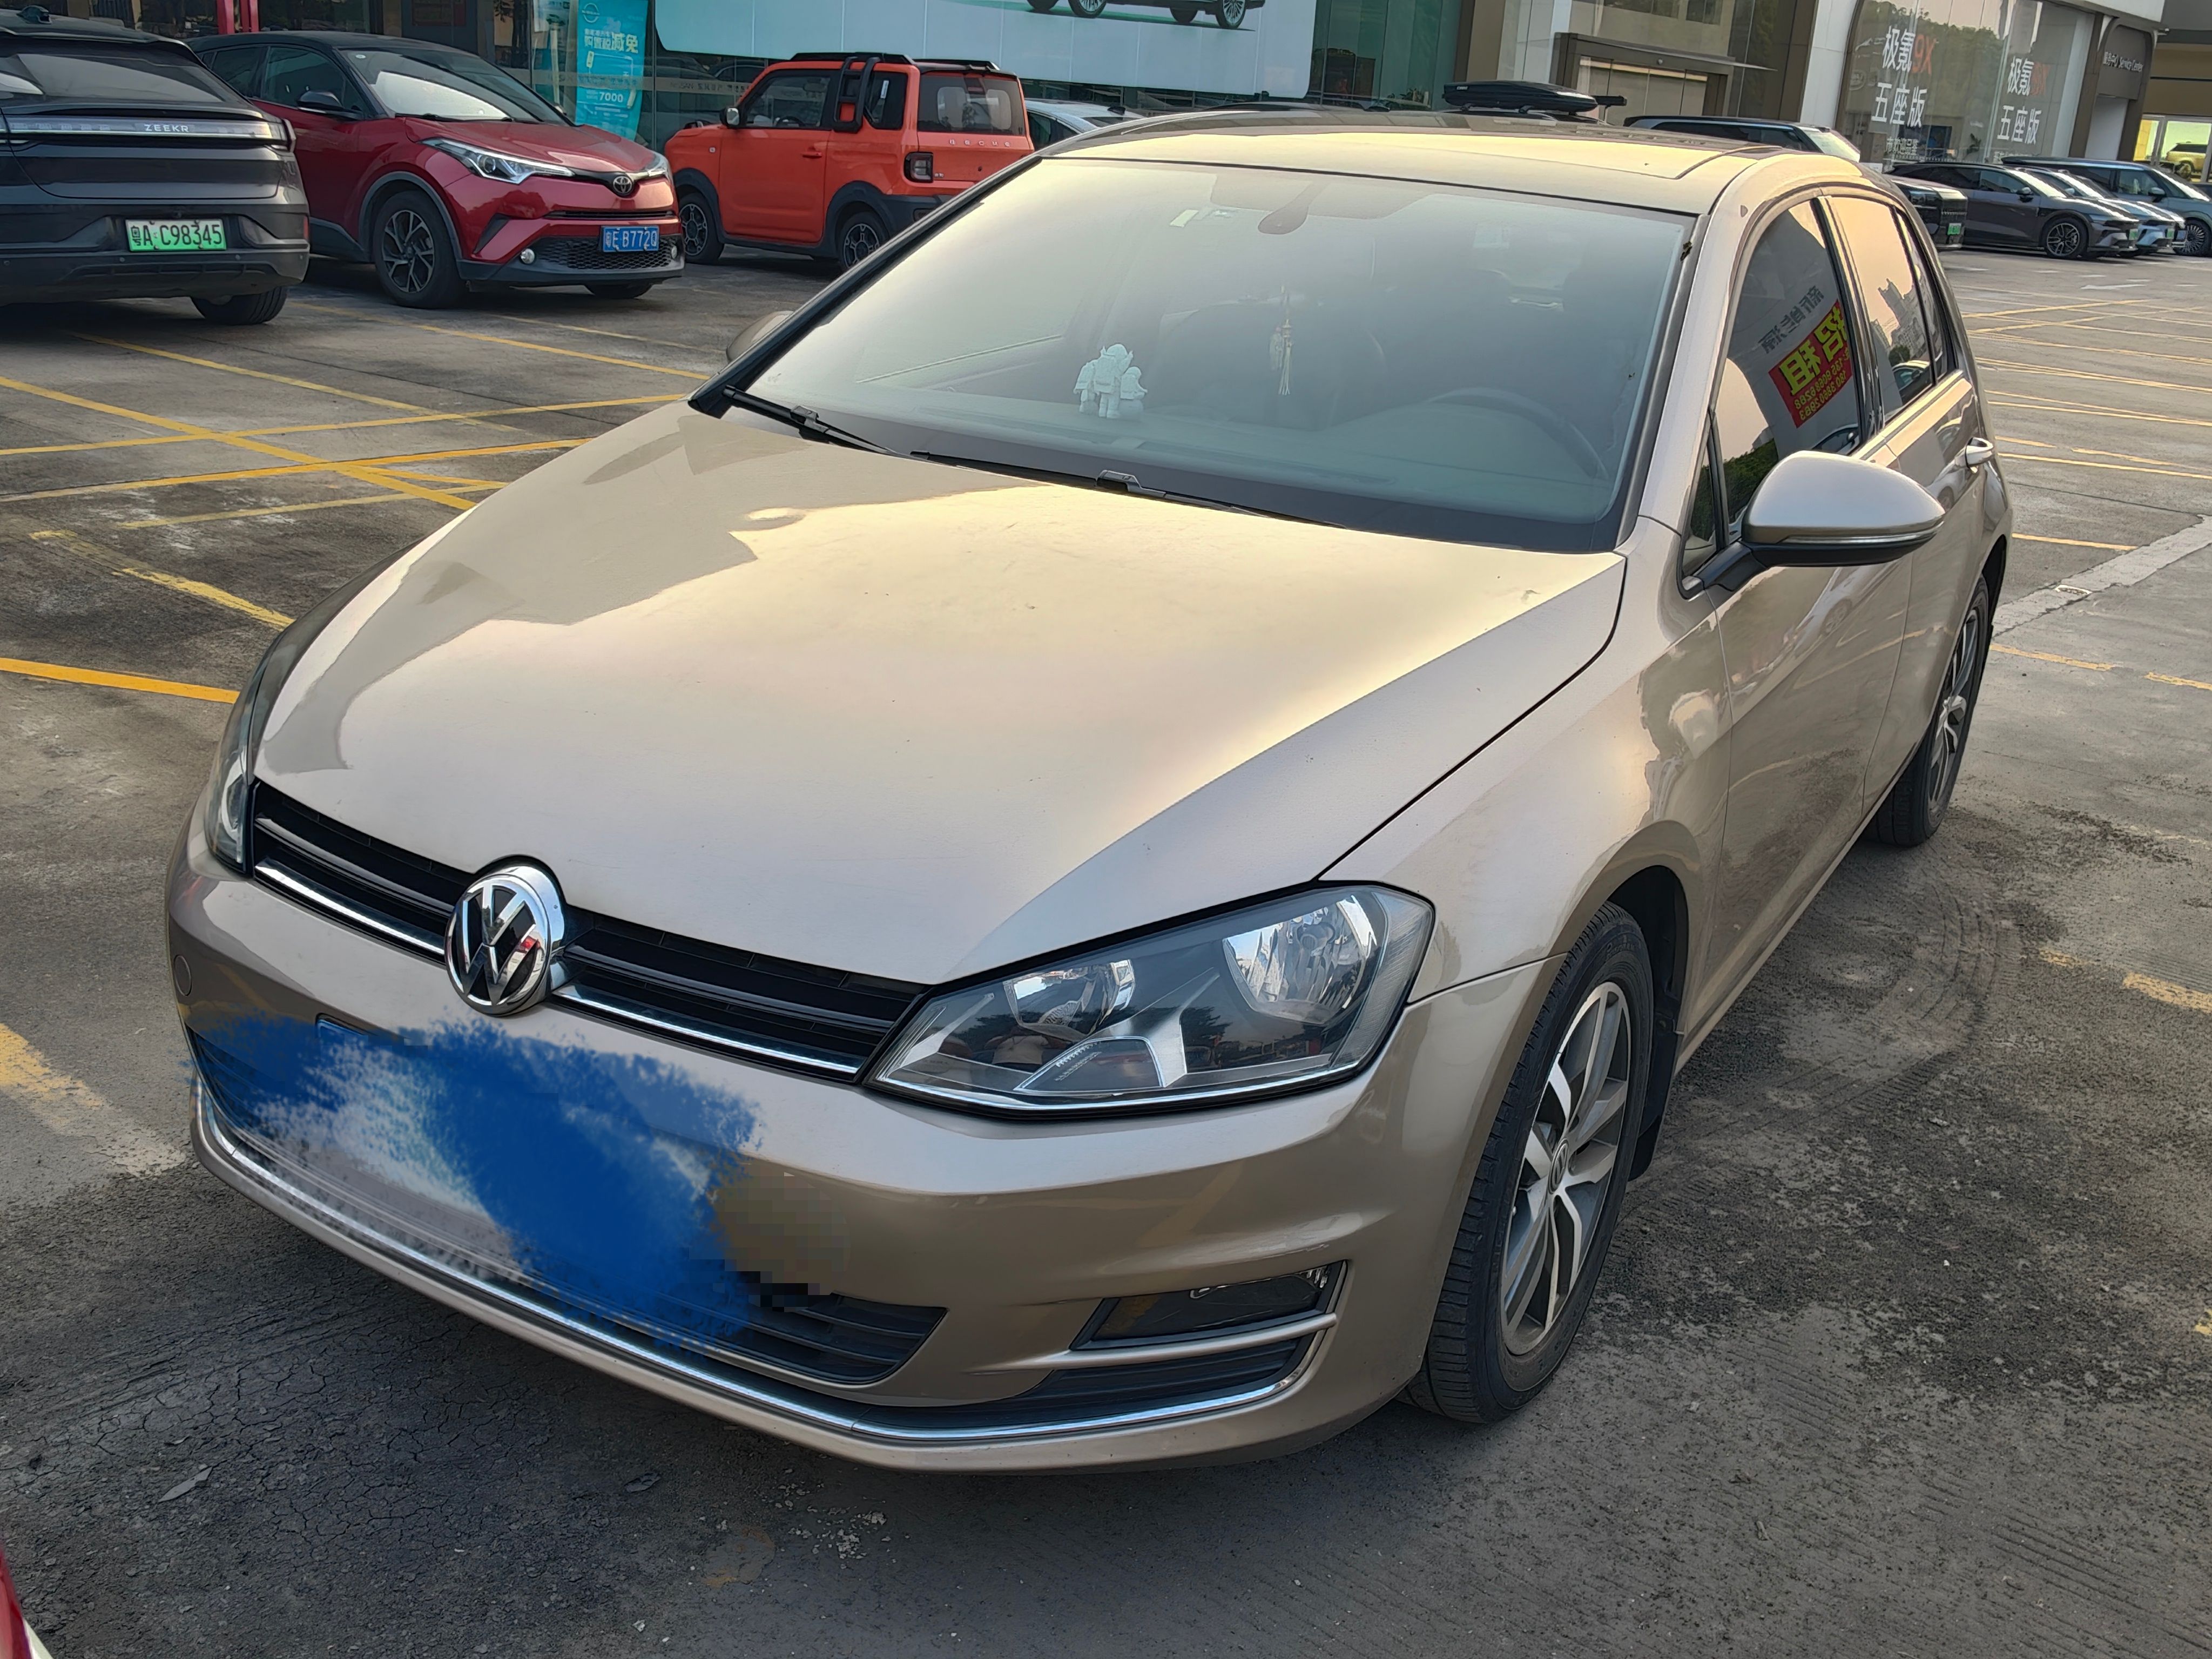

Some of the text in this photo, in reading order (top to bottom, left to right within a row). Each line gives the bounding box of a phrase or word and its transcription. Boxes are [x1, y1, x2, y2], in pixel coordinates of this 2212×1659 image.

[599, 91, 623, 103] 7000
[1871, 82, 1927, 128] 五座版
[144, 124, 189, 133] ZEEKR
[1997, 105, 2042, 146] 五座版
